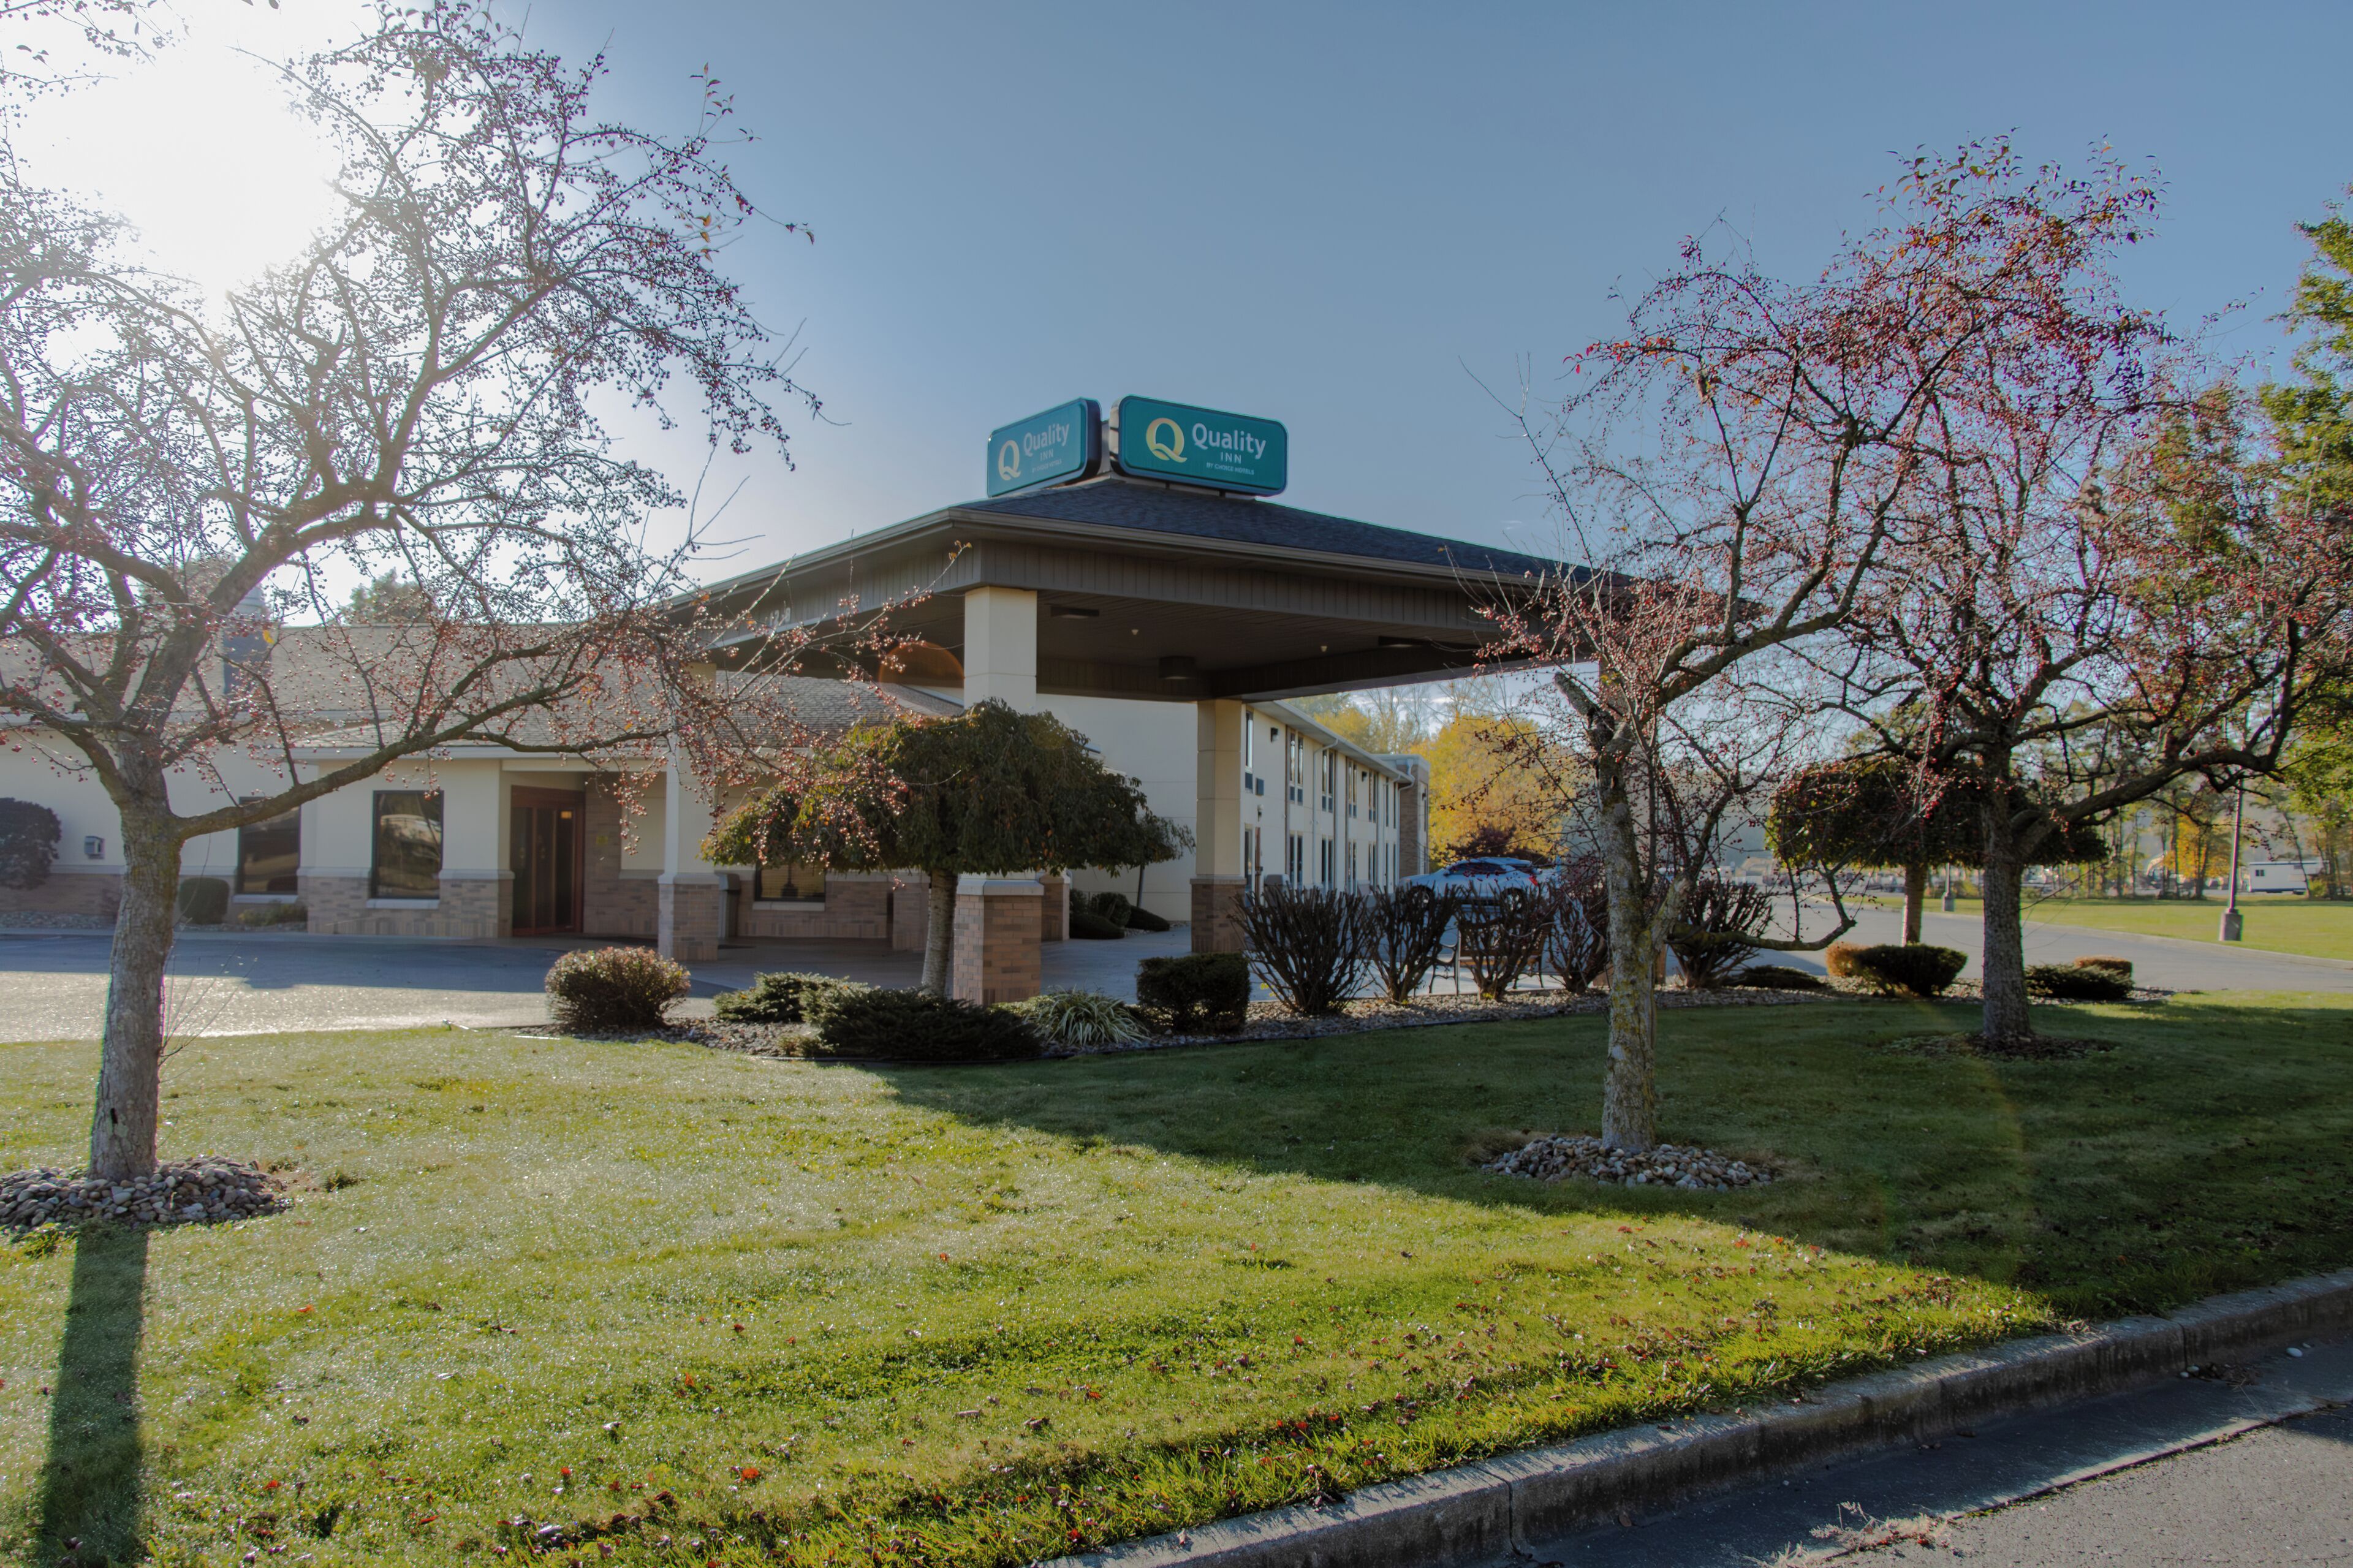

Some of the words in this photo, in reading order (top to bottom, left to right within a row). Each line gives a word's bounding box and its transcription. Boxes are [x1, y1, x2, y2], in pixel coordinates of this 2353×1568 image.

[1023, 423, 1069, 457] Quality
[1040, 449, 1054, 461] INN
[1146, 418, 1188, 463] Q
[1192, 423, 1266, 460] Quality
[998, 440, 1021, 480] Q
[1214, 463, 1233, 472] CHOICE
[1235, 467, 1254, 475] HOTELS
[1220, 452, 1241, 464] INN
